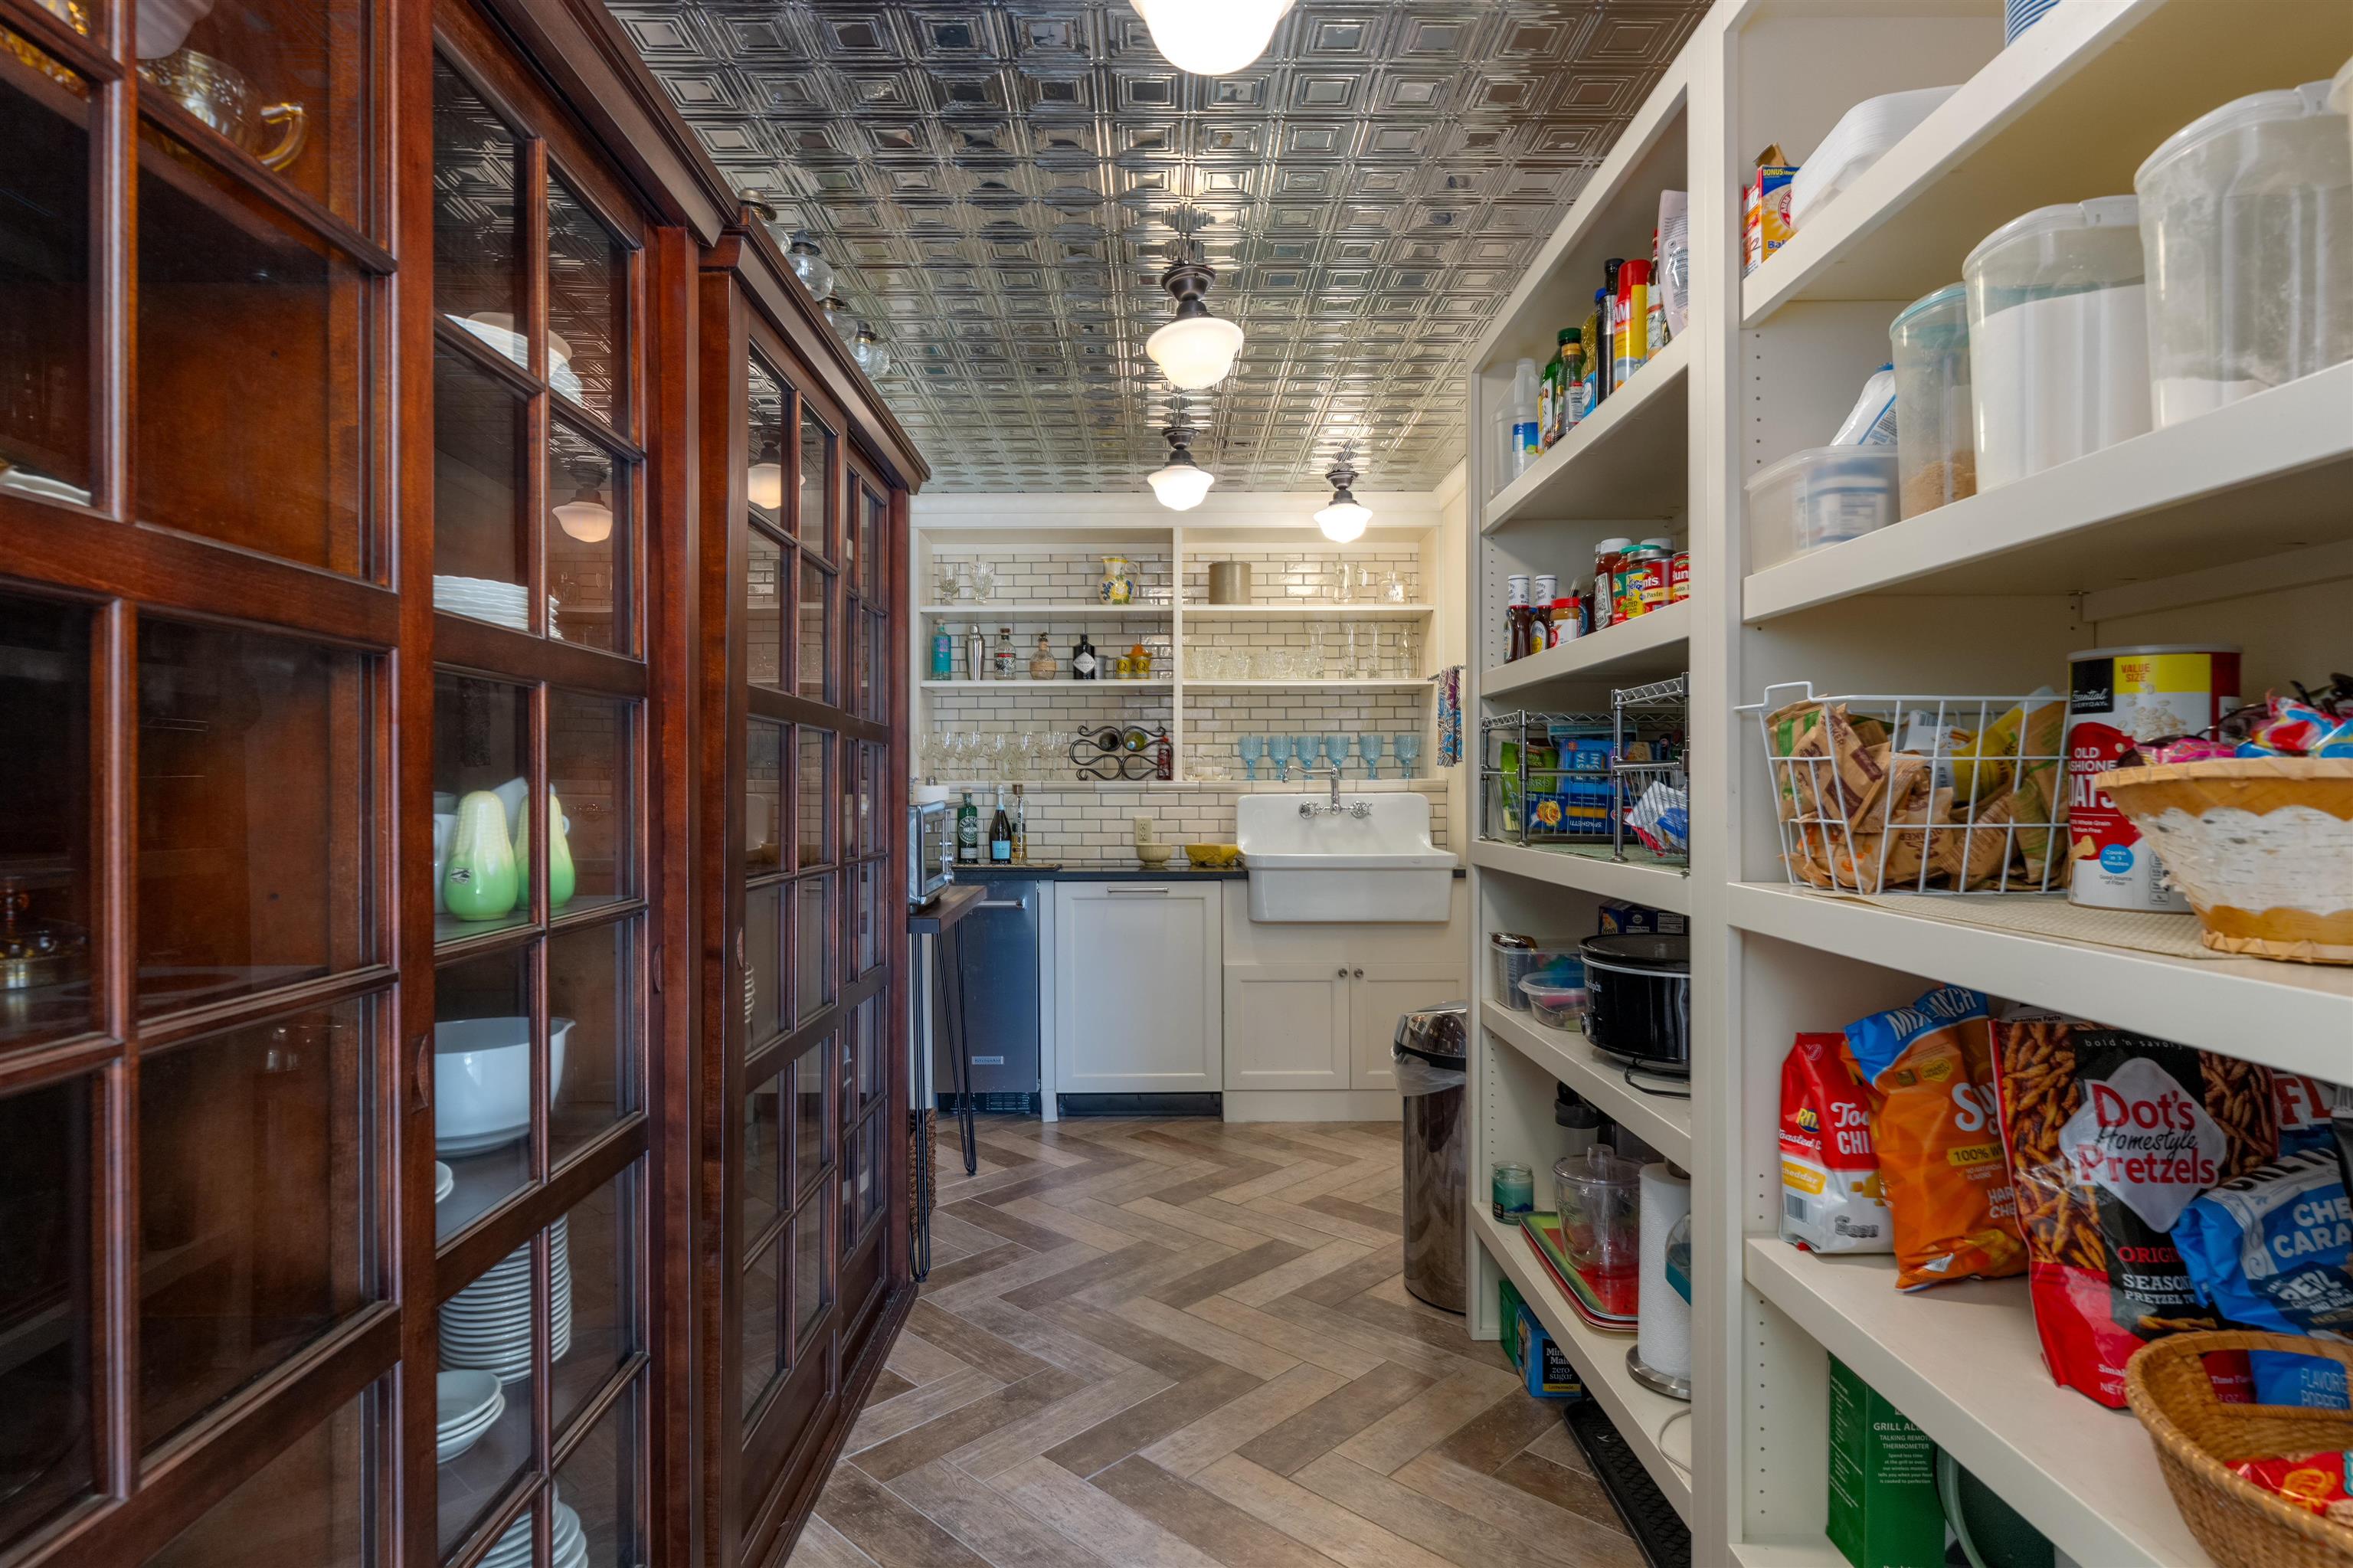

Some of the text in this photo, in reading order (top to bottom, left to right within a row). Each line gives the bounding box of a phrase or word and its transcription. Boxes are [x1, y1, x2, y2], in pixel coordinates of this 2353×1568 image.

[2121, 663, 2151, 673] VALUE
[2126, 673, 2146, 683] SIZE
[2074, 747, 2100, 759] OLD
[1576, 753, 1587, 780] PSTA
[2092, 1083, 2195, 1131] Dot's
[2094, 1125, 2198, 1162] Homestyle
[1953, 1147, 1988, 1162] 100%
[2076, 1144, 2215, 1184] Pretzels
[2124, 1290, 2182, 1304] PRETZEL
[2099, 1383, 2123, 1396] NET
[1874, 1422, 1901, 1431] GRILL
